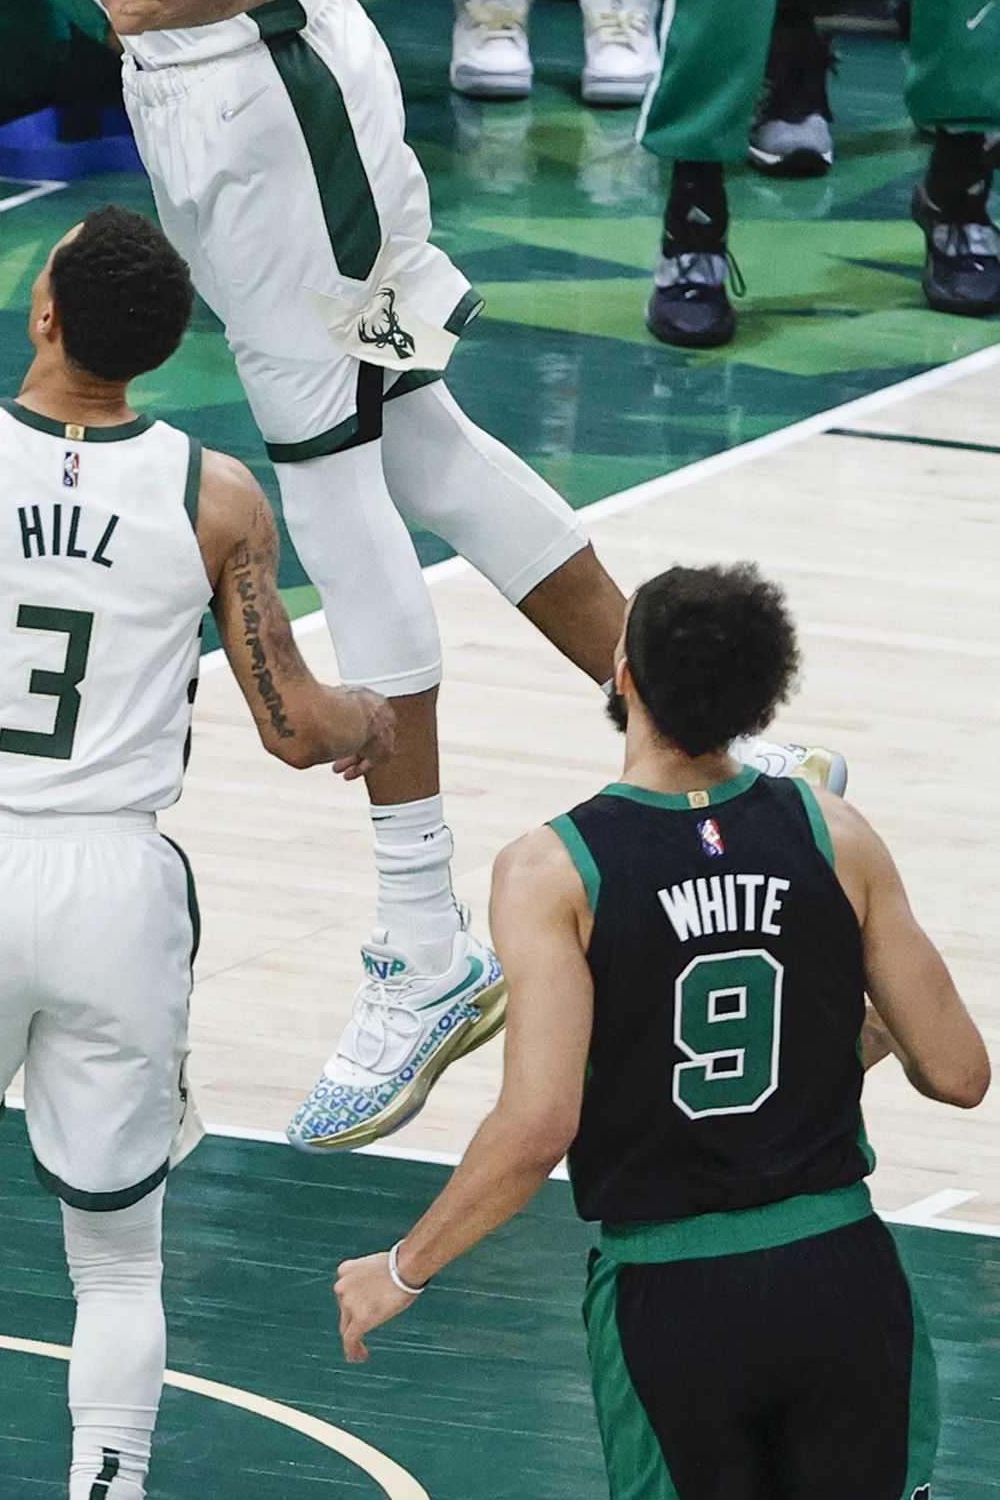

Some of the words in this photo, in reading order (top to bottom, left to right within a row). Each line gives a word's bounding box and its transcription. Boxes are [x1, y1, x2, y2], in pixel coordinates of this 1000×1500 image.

[18, 503, 120, 568] HILL
[657, 874, 790, 942] WHITE
[361, 950, 406, 979] MVP
[672, 948, 784, 1120] 9
